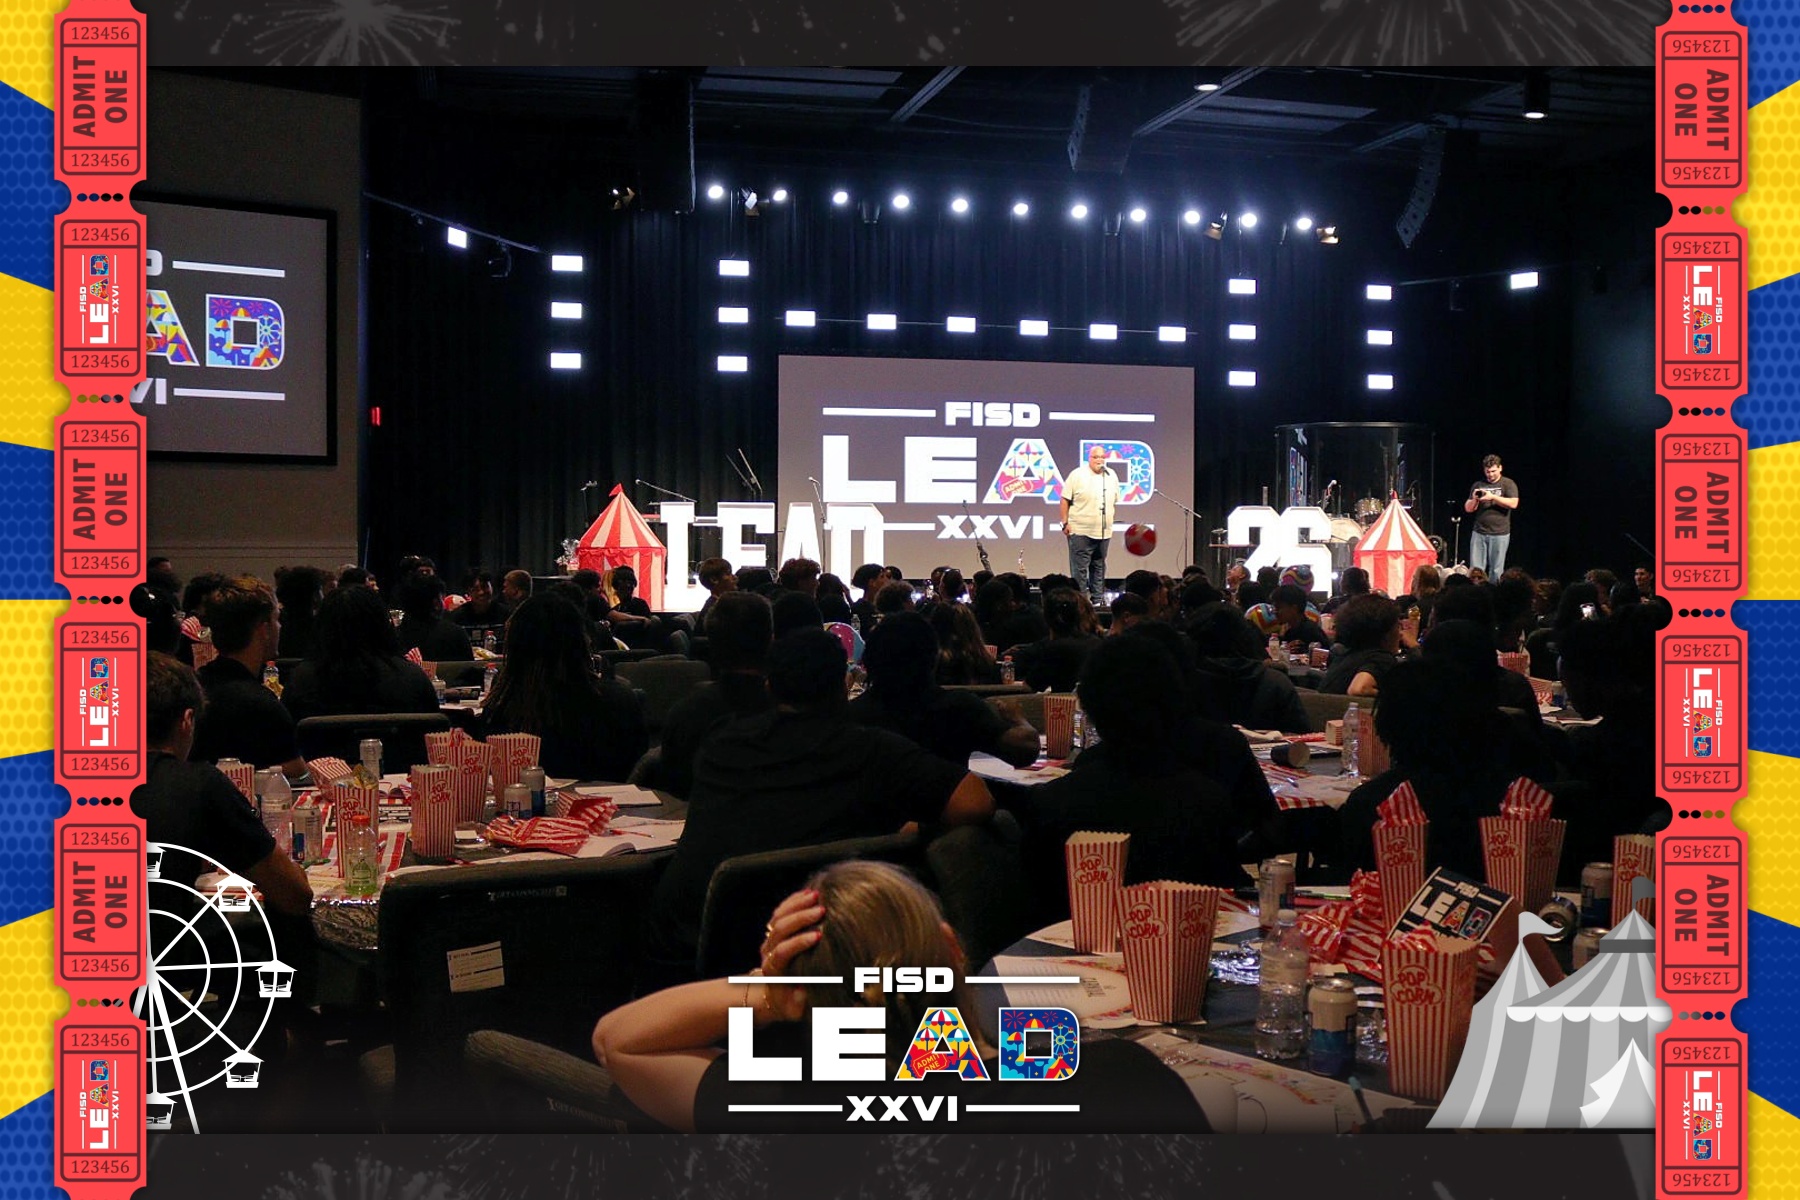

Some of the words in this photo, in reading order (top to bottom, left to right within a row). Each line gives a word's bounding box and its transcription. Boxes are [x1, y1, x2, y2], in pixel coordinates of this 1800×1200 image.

[147, 290, 284, 370] AD
[945, 401, 1041, 427] FISD
[823, 435, 1155, 504] LEAD
[937, 515, 1044, 540] XXVI
[1226, 505, 1332, 599] 26
[343, 801, 358, 811] POP
[1080, 858, 1102, 873] POP
[1079, 870, 1108, 885] CORN
[1128, 908, 1152, 924] POP
[1409, 885, 1493, 940] LEAD
[1129, 922, 1160, 940] CORN
[1398, 970, 1426, 987] POP
[1396, 986, 1436, 1004] CORN
